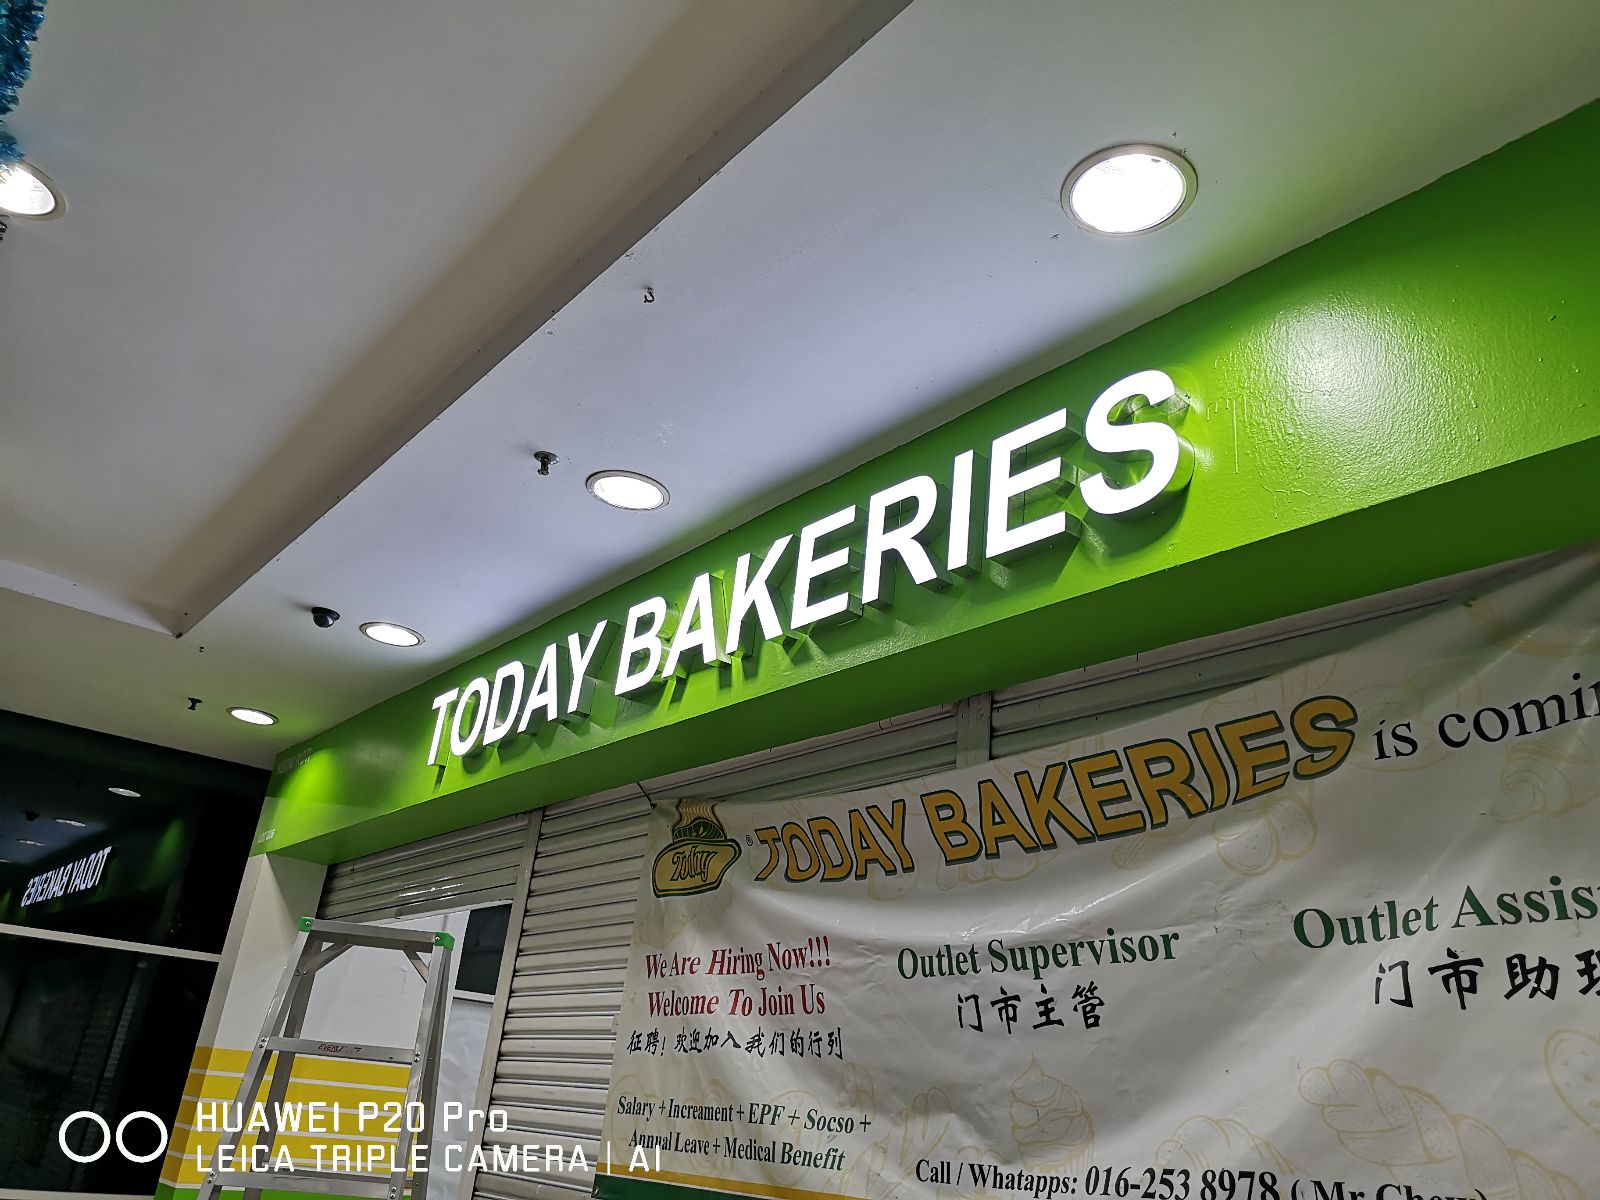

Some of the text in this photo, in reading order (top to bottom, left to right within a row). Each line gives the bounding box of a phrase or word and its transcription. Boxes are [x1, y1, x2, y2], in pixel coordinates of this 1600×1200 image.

[427, 369, 1181, 766] TODAY BAKERIES
[754, 799, 914, 882] TODAY
[921, 696, 1358, 865] BAKERIES
[1372, 720, 1418, 760] is
[670, 846, 718, 882] Today
[1293, 875, 1600, 948] Outlet Assis
[646, 935, 831, 980] We Are Hiring Now!!!
[897, 928, 1180, 981] Outlet Supervisor
[648, 984, 826, 1017] Welcome To Join Us
[957, 980, 1105, 1034] 门市主管
[617, 1095, 655, 1122] Salary
[667, 1098, 734, 1122] Increament
[748, 1102, 785, 1126] EPF
[803, 1108, 854, 1133] Socso
[628, 1128, 672, 1152] Annual
[673, 1131, 710, 1156] Leave
[723, 1136, 776, 1162] Medical
[780, 1142, 846, 1171] Benefit
[915, 1158, 951, 1185] Call
[968, 1163, 1078, 1199] Whatapps:
[1085, 1165, 1190, 1200] 016-253
[1200, 1168, 1278, 1200] 8978
